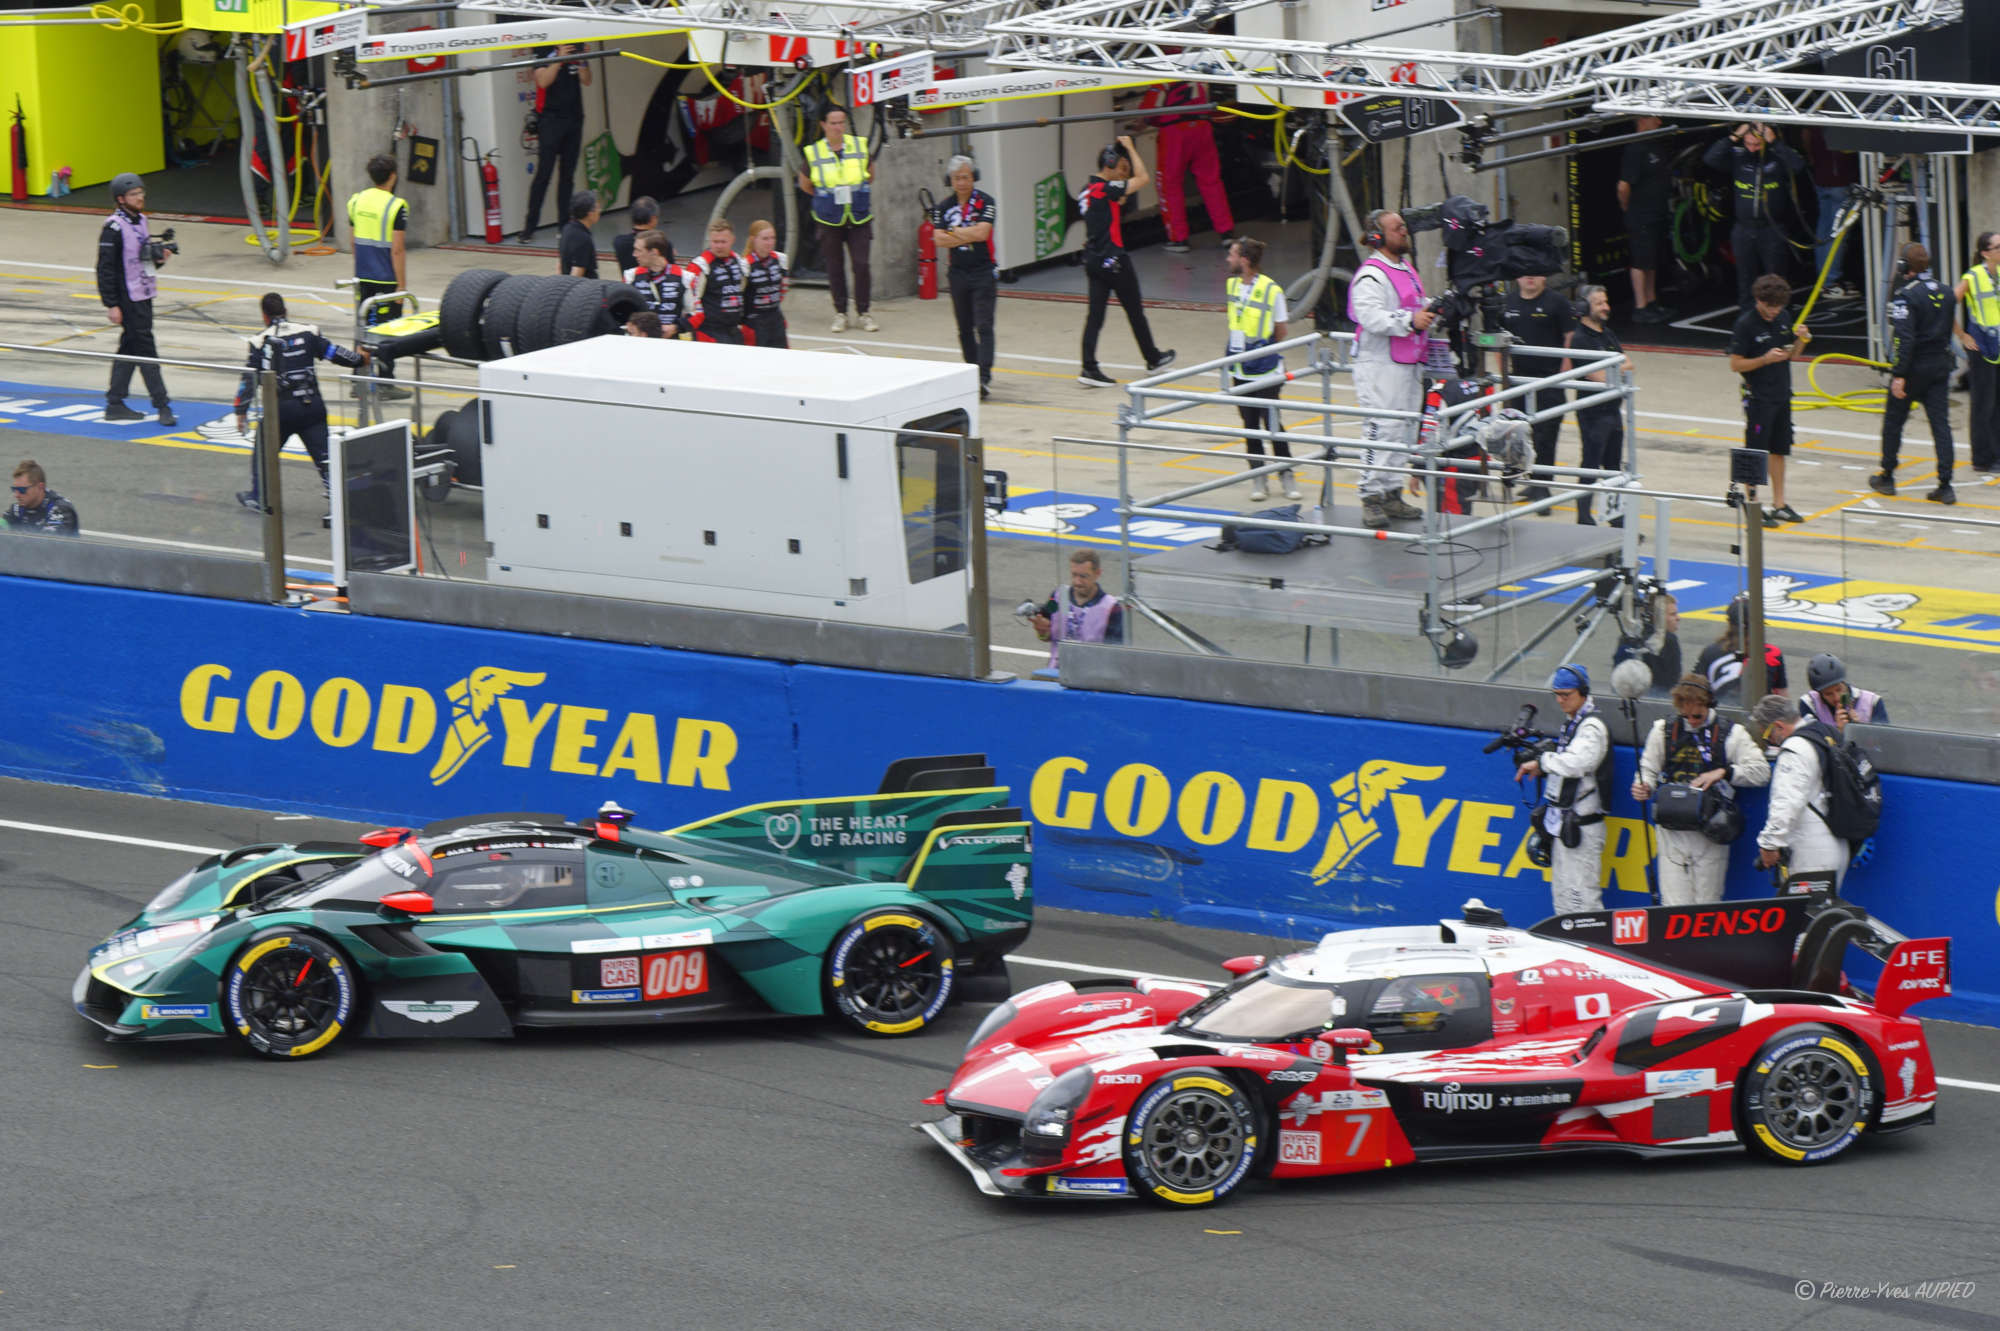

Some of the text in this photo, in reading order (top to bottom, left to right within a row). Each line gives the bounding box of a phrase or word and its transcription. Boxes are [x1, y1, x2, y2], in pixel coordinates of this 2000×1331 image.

[289, 29, 303, 59] 7
[390, 41, 445, 54] TOYOTA
[448, 37, 498, 49] GAZOO
[501, 32, 549, 45] Racing
[1865, 45, 1918, 81] 61
[856, 72, 871, 105] 8
[943, 89, 999, 102] TOYOTA
[1001, 82, 1052, 95] GAZOO
[1055, 76, 1102, 89] Racing
[808, 814, 909, 831] THE HEART
[811, 831, 907, 847] OF RACING
[1615, 916, 1645, 939] HY
[1664, 907, 1786, 940] DENSO
[1893, 950, 1944, 967] JFE
[605, 969, 637, 985] CAR
[646, 951, 704, 996] 009
[1098, 1074, 1143, 1084] AISIN
[1136, 1084, 1171, 1128] MICHELIN
[1423, 1091, 1493, 1113] FUJITSU
[1282, 1135, 1316, 1144] HYPER
[1344, 1114, 1372, 1157] 7
[1282, 1144, 1318, 1160] CAR
[1217, 1153, 1251, 1196] MICHELIN
